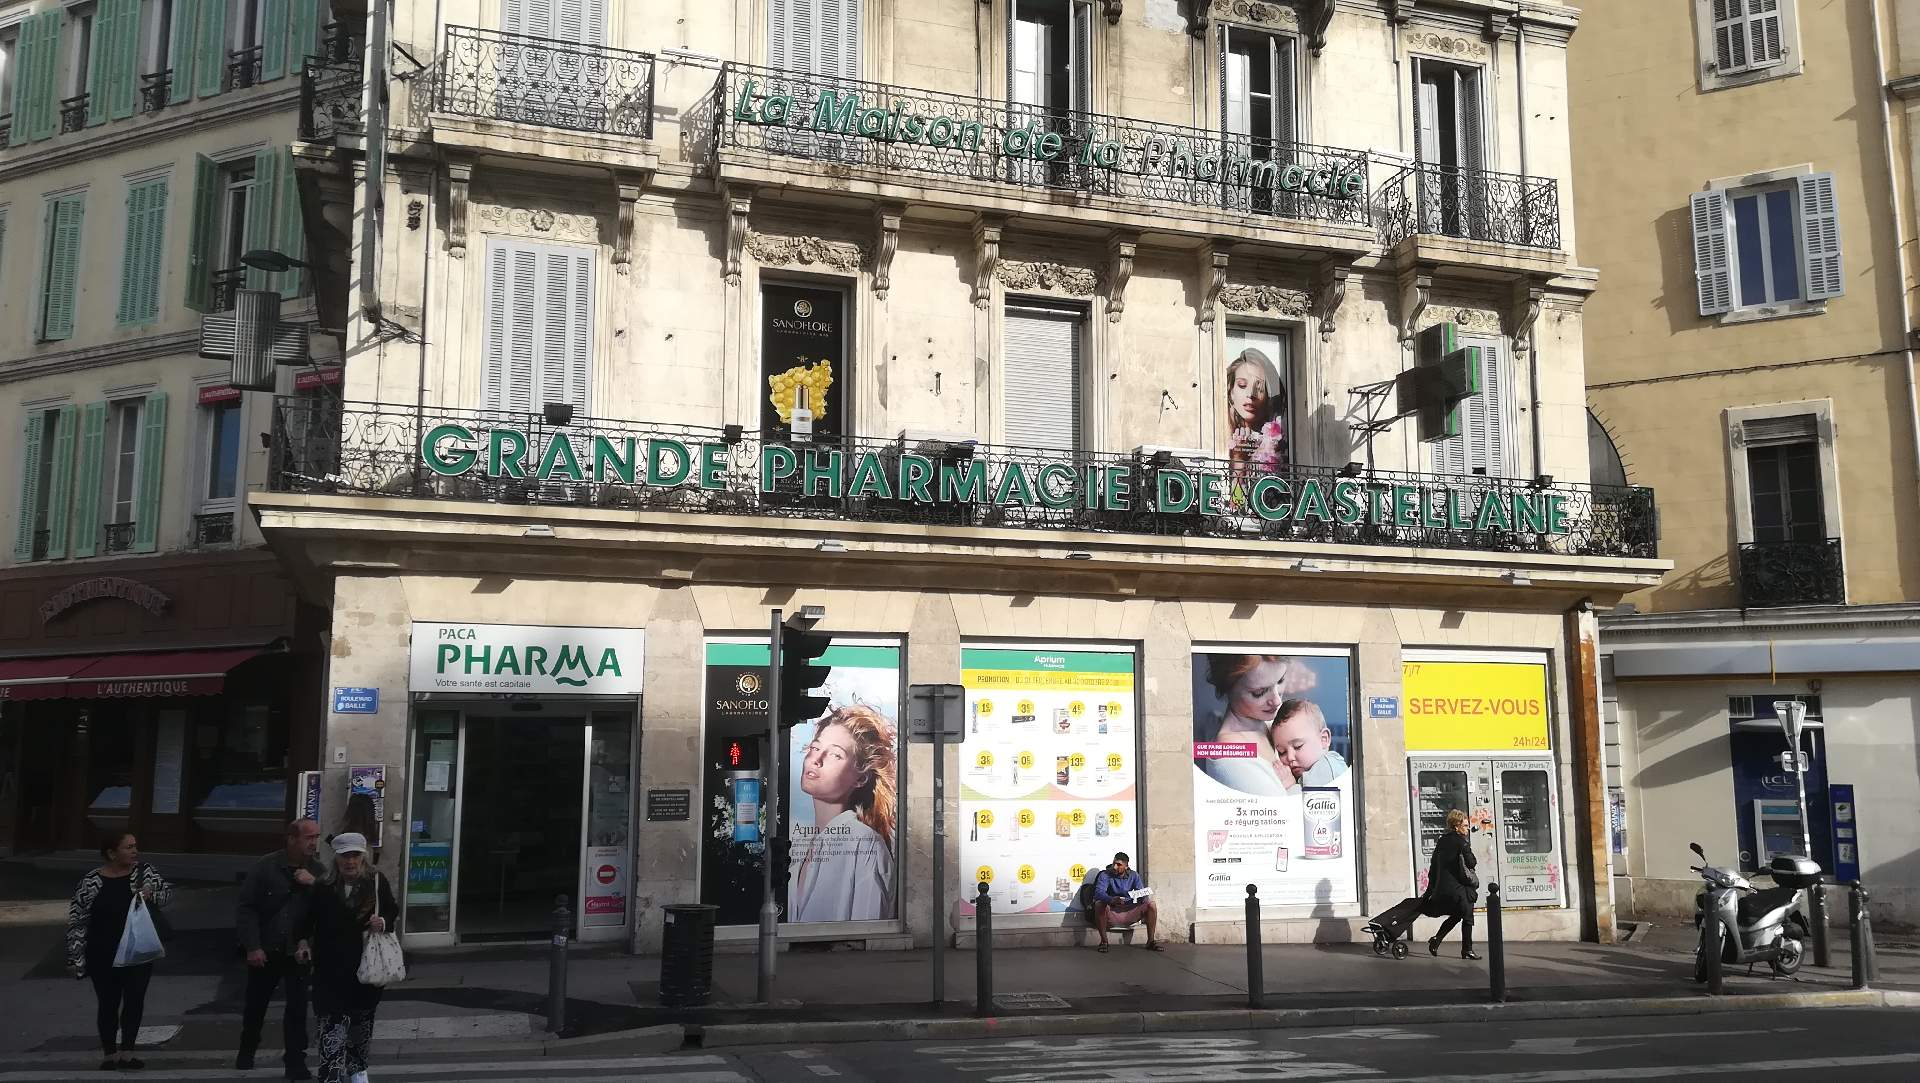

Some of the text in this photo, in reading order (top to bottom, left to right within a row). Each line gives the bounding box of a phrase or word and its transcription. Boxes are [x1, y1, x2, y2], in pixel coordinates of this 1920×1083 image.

[734, 80, 1364, 199] La Maison de la Pharmacie
[422, 423, 1570, 535] GRANDE PHARMACIE DE CASTELLANE
[438, 628, 476, 640] PACA
[436, 644, 623, 680] PHARMA
[1034, 656, 1066, 666] Aprium
[97, 681, 188, 695] L'AUTHENTIQUE
[435, 679, 457, 687] Votre
[484, 680, 497, 688] est
[716, 700, 769, 710] SANOFLO
[1409, 698, 1540, 716] SERVEZ-VOUS
[1512, 736, 1547, 748] 24h/24
[1764, 775, 1793, 784] LCL
[1306, 798, 1336, 811] Gallia
[1236, 807, 1278, 817] 3x moins
[1235, 819, 1287, 827] régurgtations
[792, 822, 820, 838] Aqua
[1506, 855, 1549, 864] LIBRE SERVIC
[1507, 884, 1553, 893] SERVEZ-VOUS
